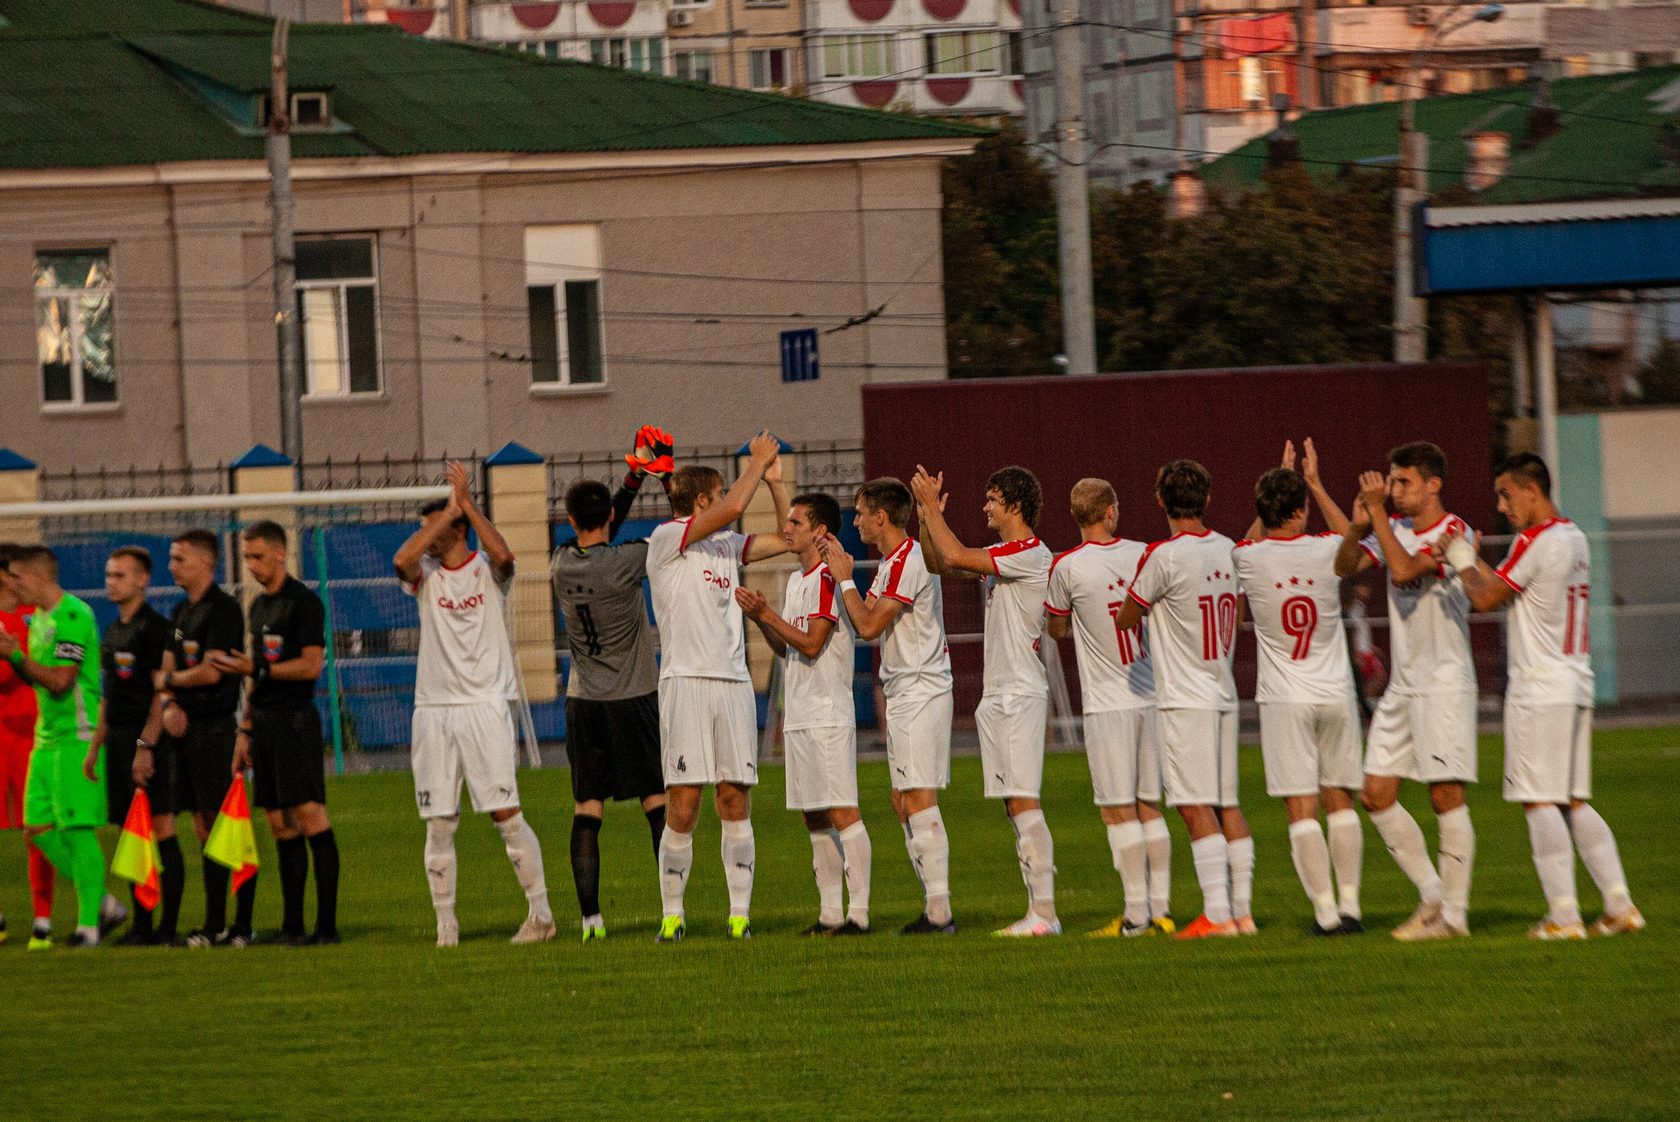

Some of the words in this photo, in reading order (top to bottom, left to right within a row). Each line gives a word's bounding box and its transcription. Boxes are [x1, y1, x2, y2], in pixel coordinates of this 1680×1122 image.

[575, 602, 602, 656] 1
[1198, 592, 1237, 661] 10
[1281, 595, 1318, 660] 9
[677, 755, 687, 772] 4
